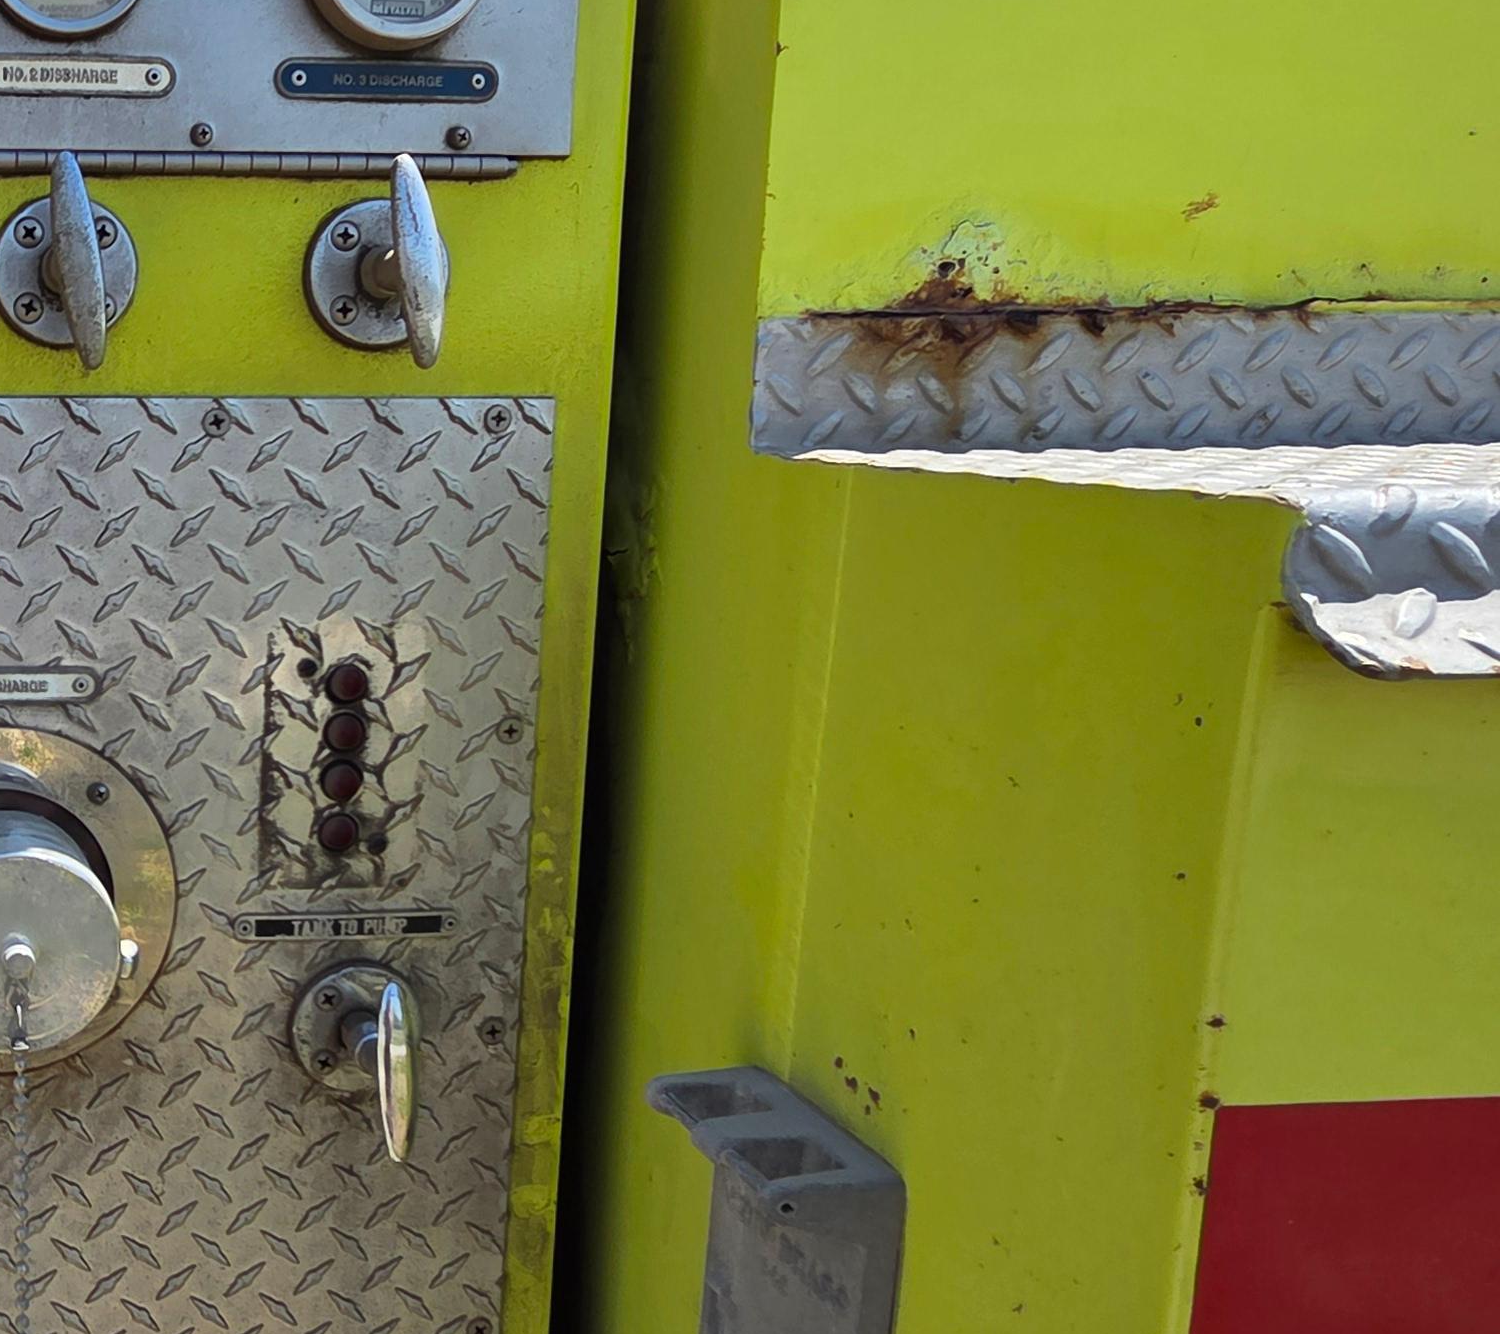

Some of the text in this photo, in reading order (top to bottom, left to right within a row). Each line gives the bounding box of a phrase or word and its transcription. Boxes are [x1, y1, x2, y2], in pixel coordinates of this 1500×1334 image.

[2, 66, 119, 84] NO. 2 DISCHARGE
[332, 73, 444, 88] NO. 3 DISCHARGE
[291, 919, 335, 937] TANK
[338, 919, 360, 937] TO
